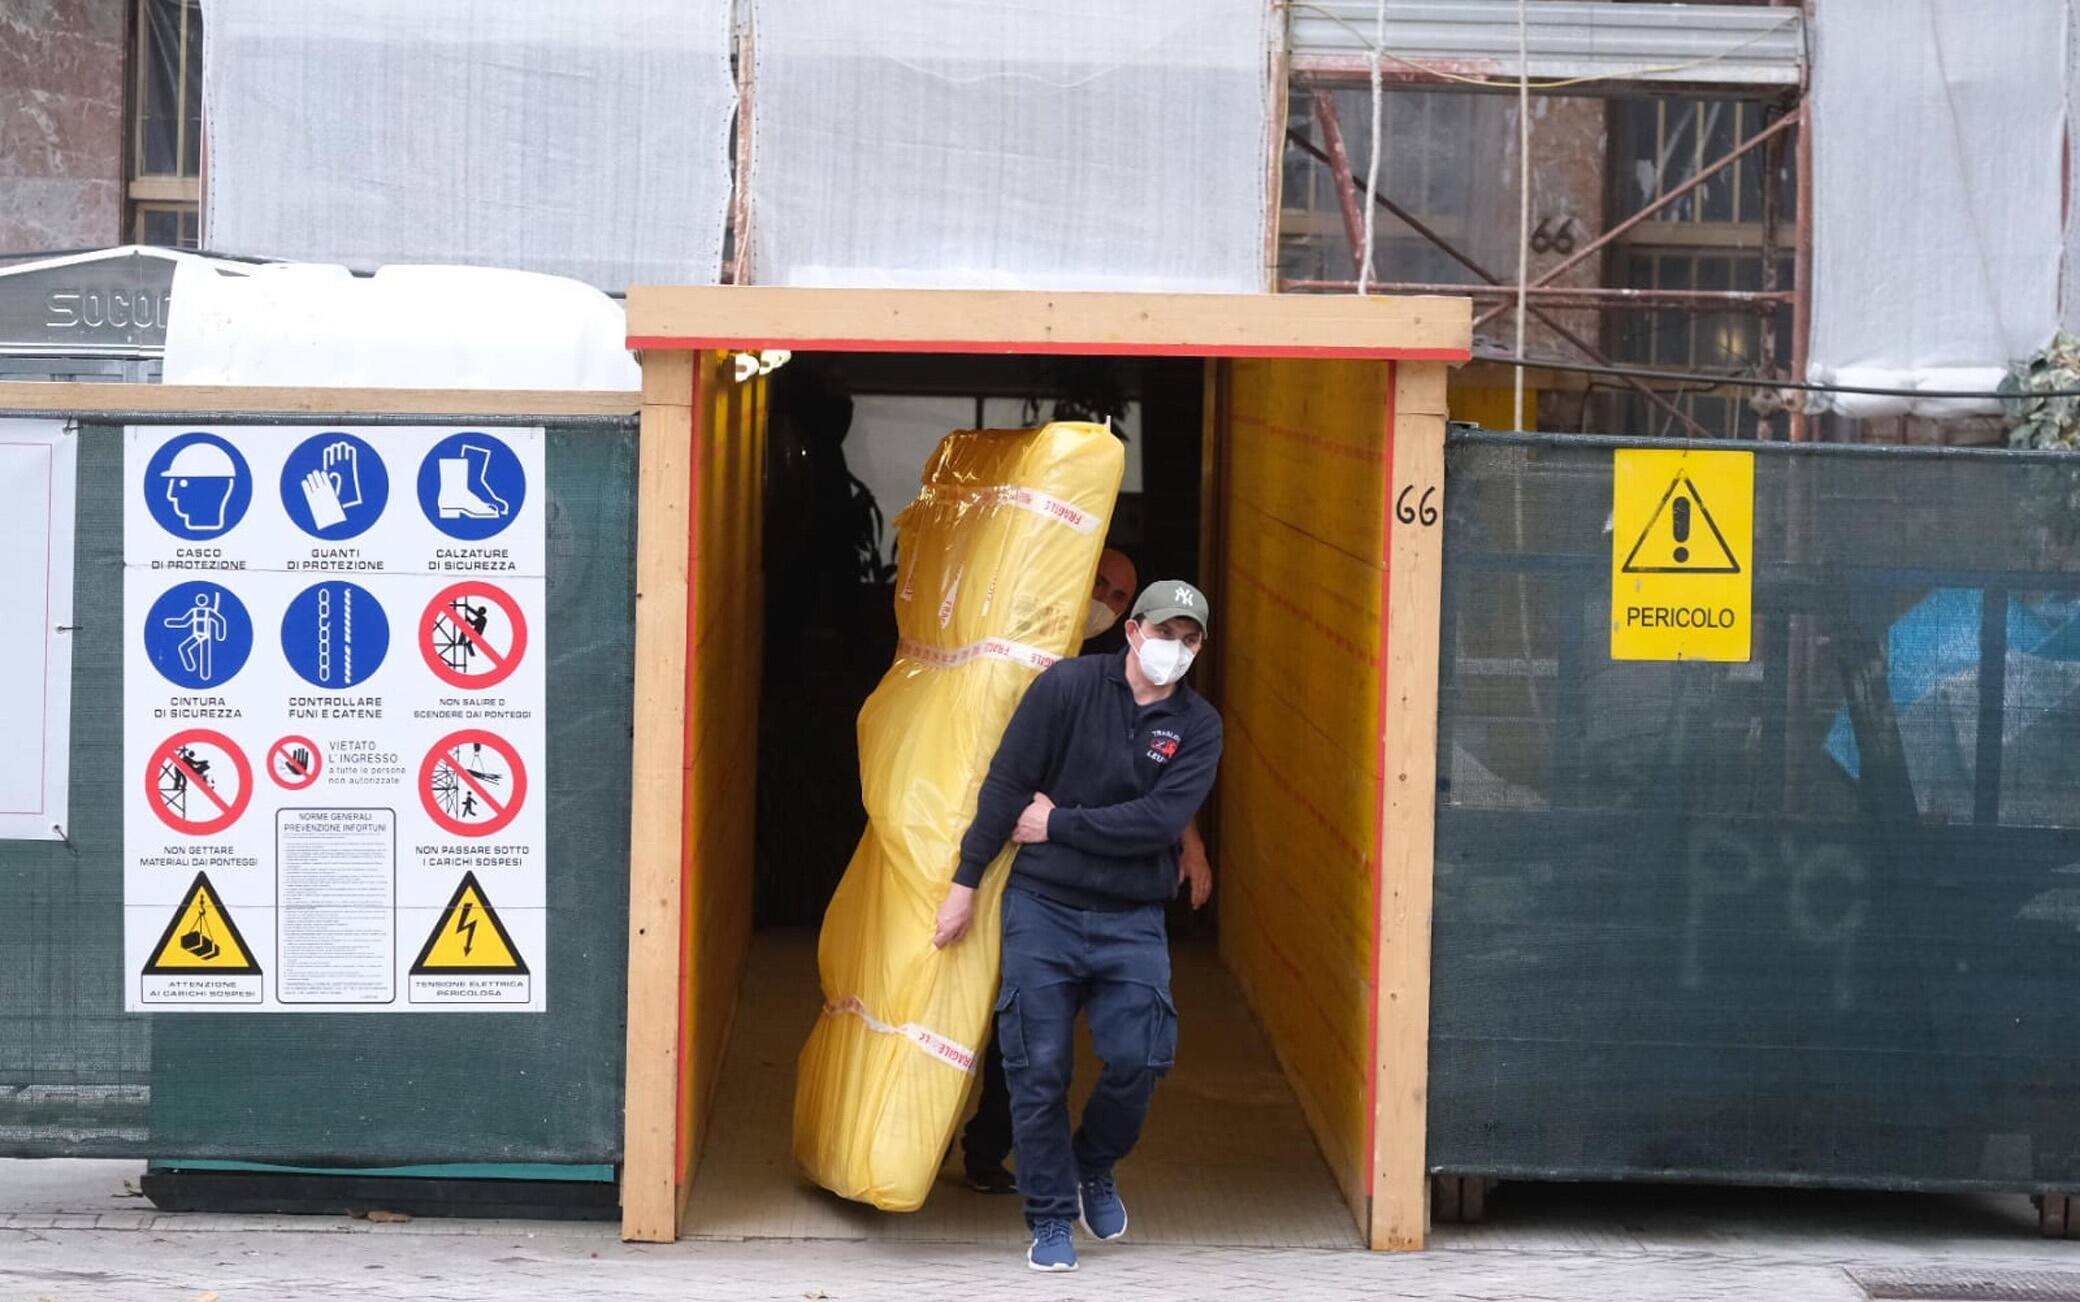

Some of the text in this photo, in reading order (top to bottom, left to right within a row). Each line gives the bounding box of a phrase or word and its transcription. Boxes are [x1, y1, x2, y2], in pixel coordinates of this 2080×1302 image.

[1531, 218, 1575, 255] 66
[1395, 484, 1438, 527] 66
[1044, 500, 1083, 525] FRAGILE
[176, 549, 222, 558] CASCO
[311, 549, 360, 558] GUANTI
[436, 549, 509, 558] CALZATURE
[151, 561, 246, 570] DI PROTEZIONE
[287, 561, 384, 570] DI PROTEZIONE
[428, 561, 516, 570] DI SICUREZZA
[1626, 606, 1735, 629] PERICOLO
[170, 697, 226, 706] CINTURA
[289, 697, 383, 707] CONTROLLARE
[154, 709, 242, 718] DI SICUREZZA
[289, 709, 383, 719] FUNI E CATENE
[484, 711, 531, 719] PONTEGGI
[329, 741, 377, 751] VIETATO
[336, 766, 357, 774] tutte
[359, 766, 369, 774] le
[371, 767, 406, 776] persone
[349, 776, 400, 784] autorizzate
[299, 812, 372, 821] NORME GENERALI
[284, 823, 341, 833] PREVENZIONE
[164, 846, 234, 855] NON GETTARE
[416, 846, 529, 855] NON PASSARE SOTTO
[140, 858, 257, 867] MATERIALI DAI PONTEGGI
[429, 858, 473, 867] CARICHI
[476, 858, 522, 867] SOSPESI
[208, 989, 255, 997] SOSPESI
